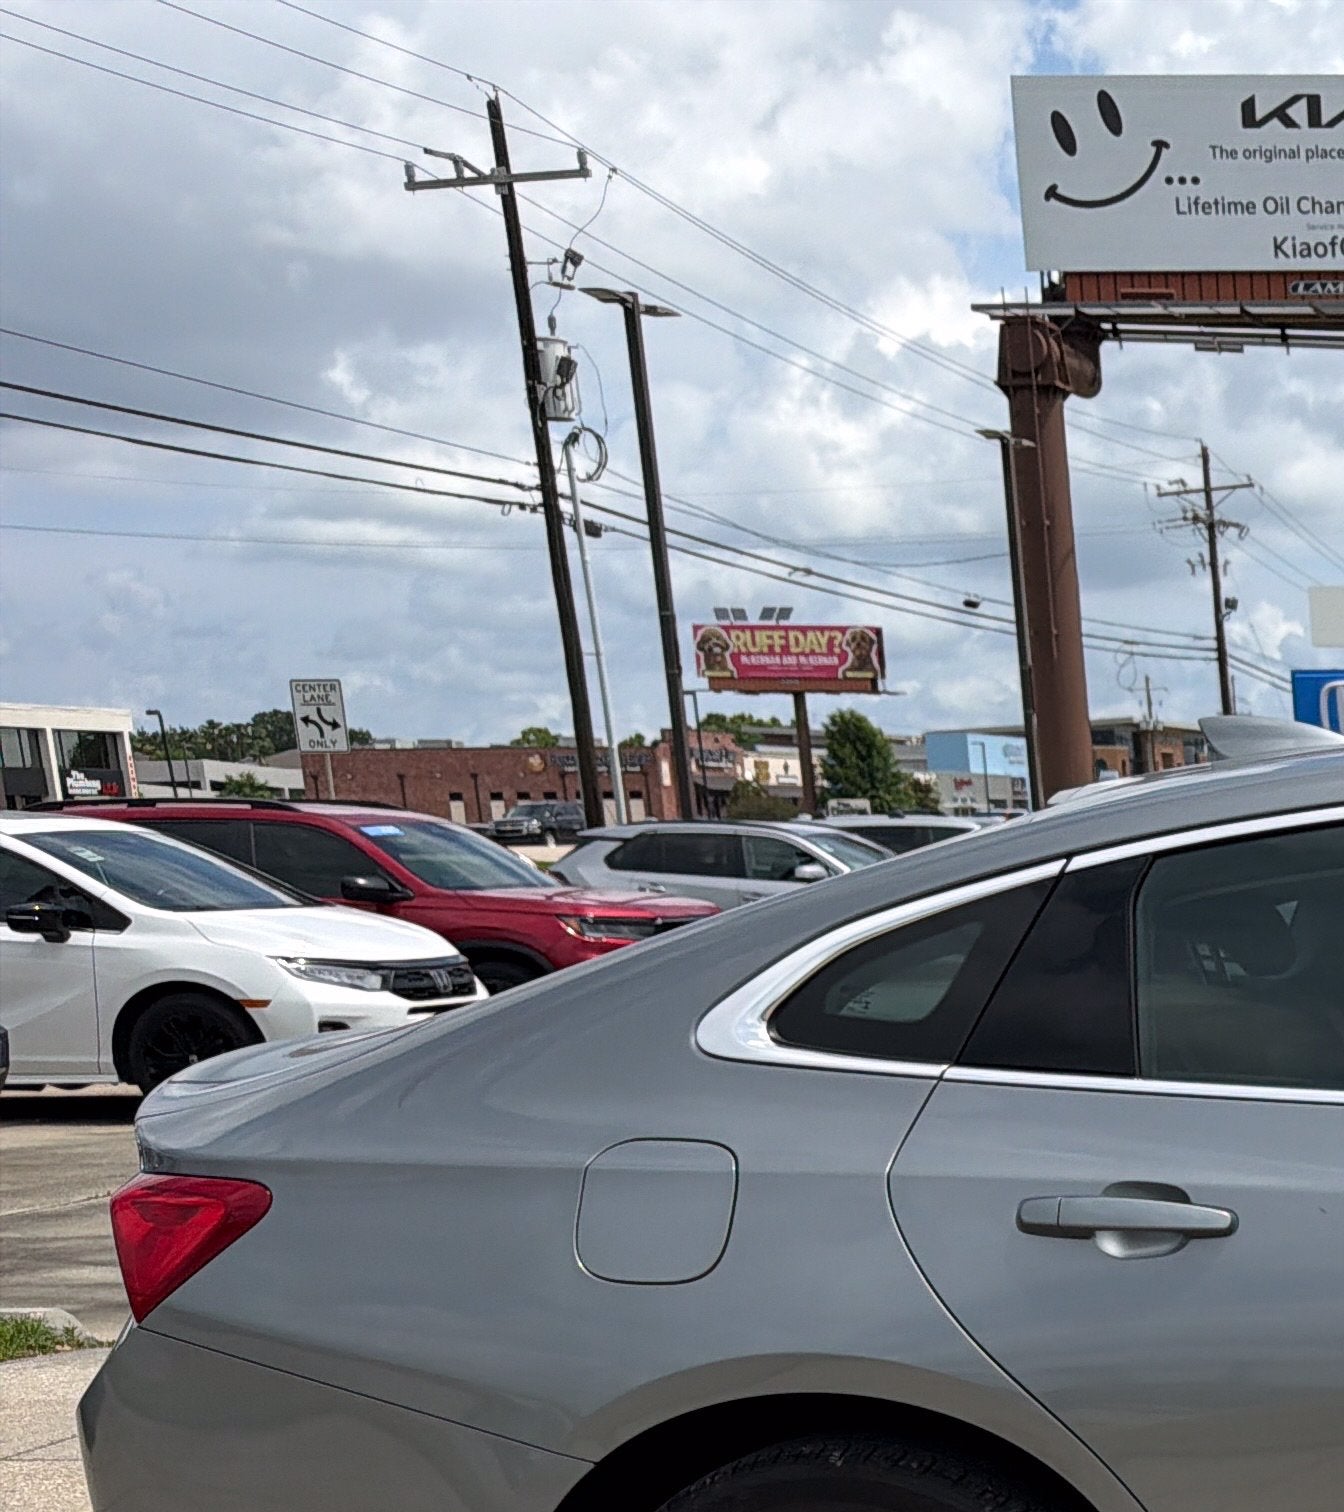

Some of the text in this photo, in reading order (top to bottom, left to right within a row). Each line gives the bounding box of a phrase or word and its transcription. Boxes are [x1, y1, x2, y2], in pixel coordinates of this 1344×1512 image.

[1209, 145, 1238, 160] The
[1242, 144, 1300, 163] original
[1306, 144, 1344, 163] place
[1175, 195, 1257, 216] Lifetime
[1262, 195, 1290, 216] Oil
[730, 630, 843, 654] RUFF DAY?
[295, 683, 337, 693] CENTER
[302, 694, 331, 703] LANE
[309, 739, 337, 749] ONLY
